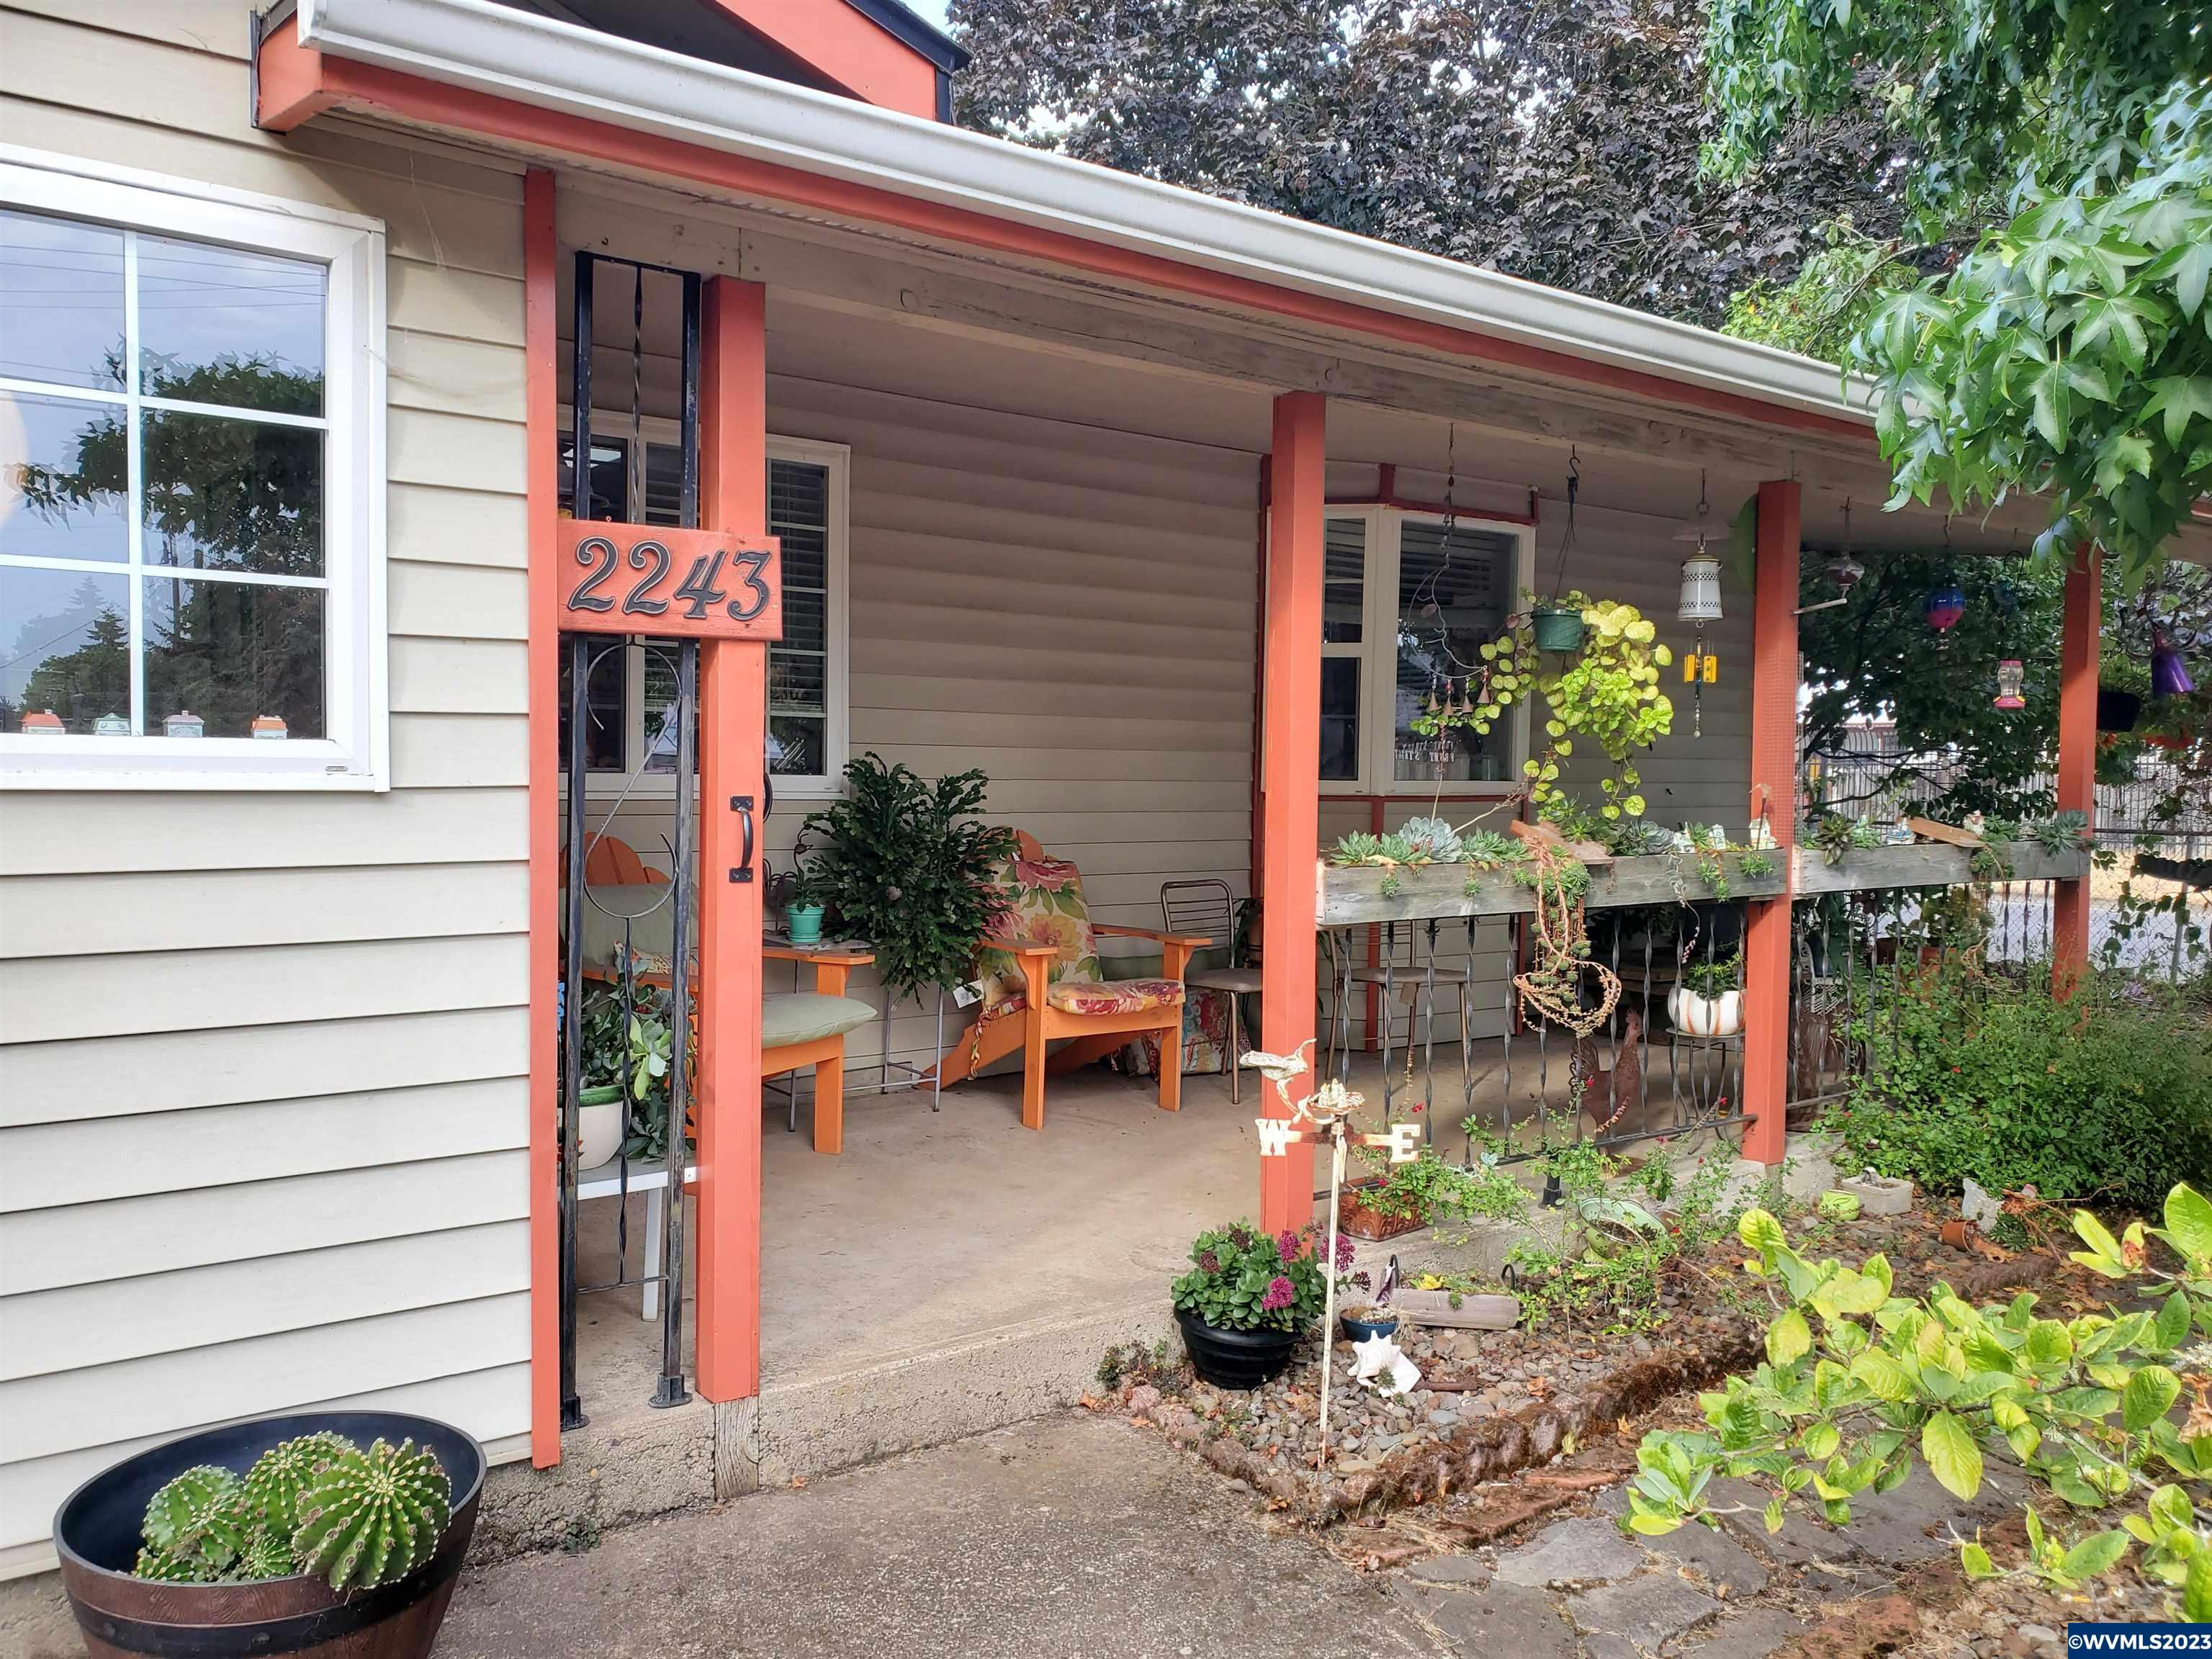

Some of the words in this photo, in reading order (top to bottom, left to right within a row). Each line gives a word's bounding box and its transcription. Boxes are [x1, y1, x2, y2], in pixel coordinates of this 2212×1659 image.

[567, 536, 772, 621] 2243
[1254, 1118, 1292, 1156] W
[1390, 1123, 1421, 1163] E
